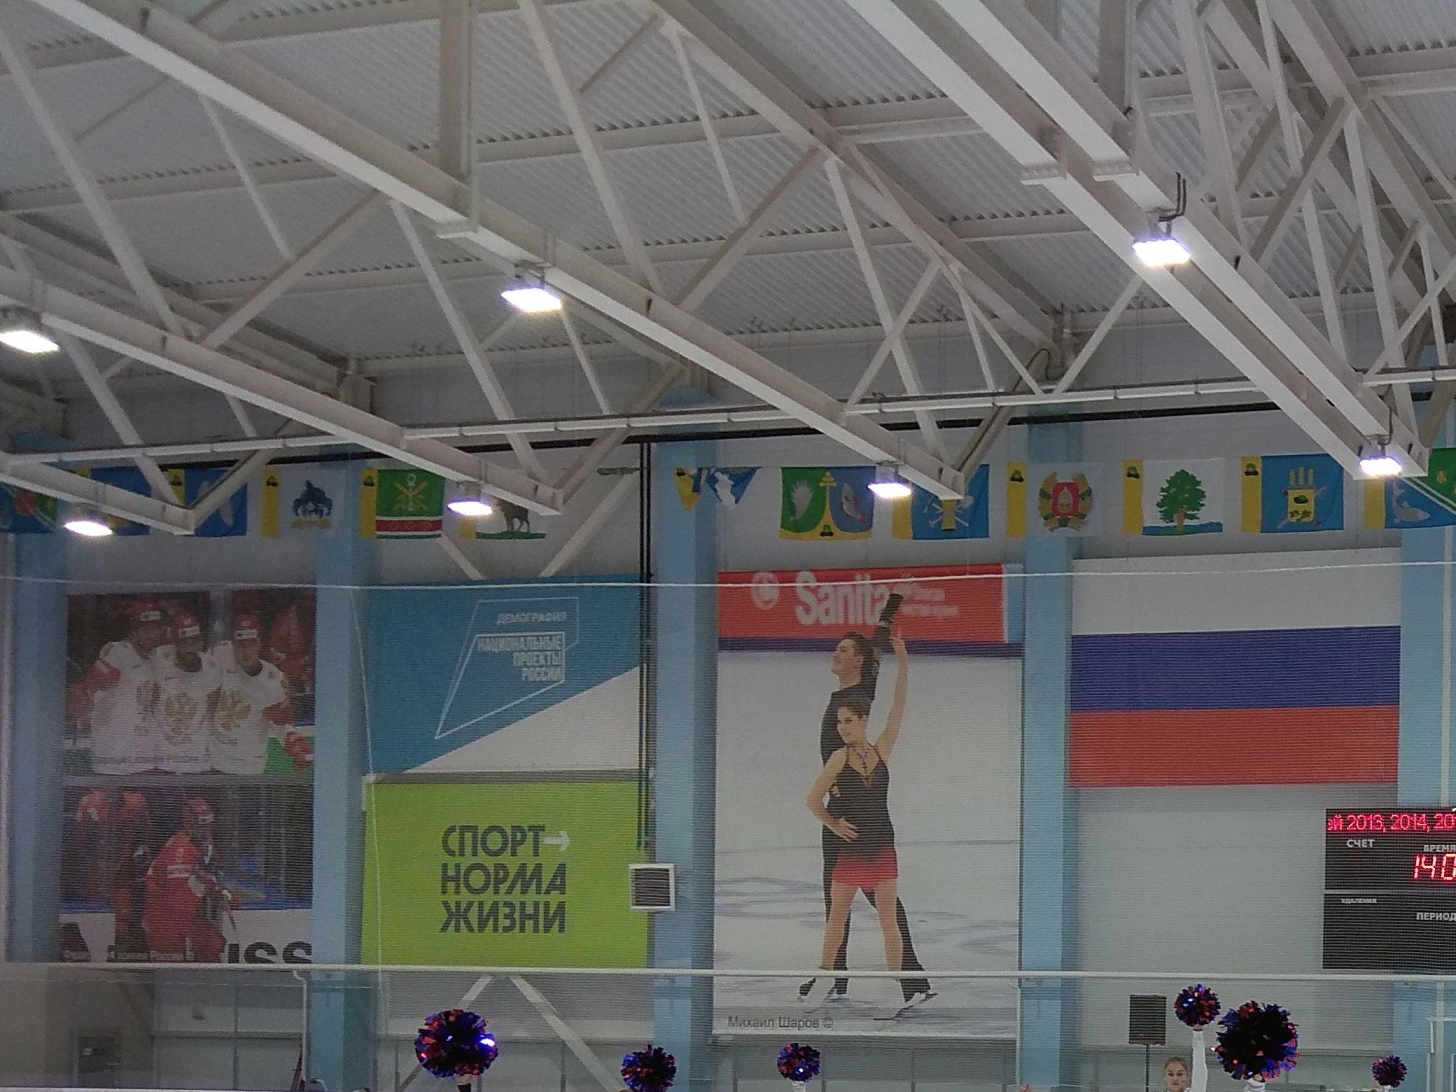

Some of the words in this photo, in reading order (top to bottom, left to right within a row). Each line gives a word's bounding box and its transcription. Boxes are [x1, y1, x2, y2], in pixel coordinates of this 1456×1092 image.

[497, 611, 567, 625] ДЕМОГРАФИЯ
[477, 636, 562, 653] НАЦИОНАЛЬНЫЕ
[513, 651, 562, 667] ПРОЕКТЫ
[521, 667, 562, 681] РОССИИ
[1346, 813, 1386, 833] 2013,
[1390, 812, 1430, 833] 2014,
[441, 824, 546, 857] СПОРТ
[1347, 839, 1375, 849] СЧЕТ
[1423, 844, 1456, 852] ВРЕМЯ
[441, 863, 566, 895] НОРМА
[440, 901, 566, 933] ЖИЗНИ
[1416, 912, 1456, 921] ПЕРИОД
[728, 1016, 774, 1028] Михаил
[779, 1016, 819, 1030] Шаров
